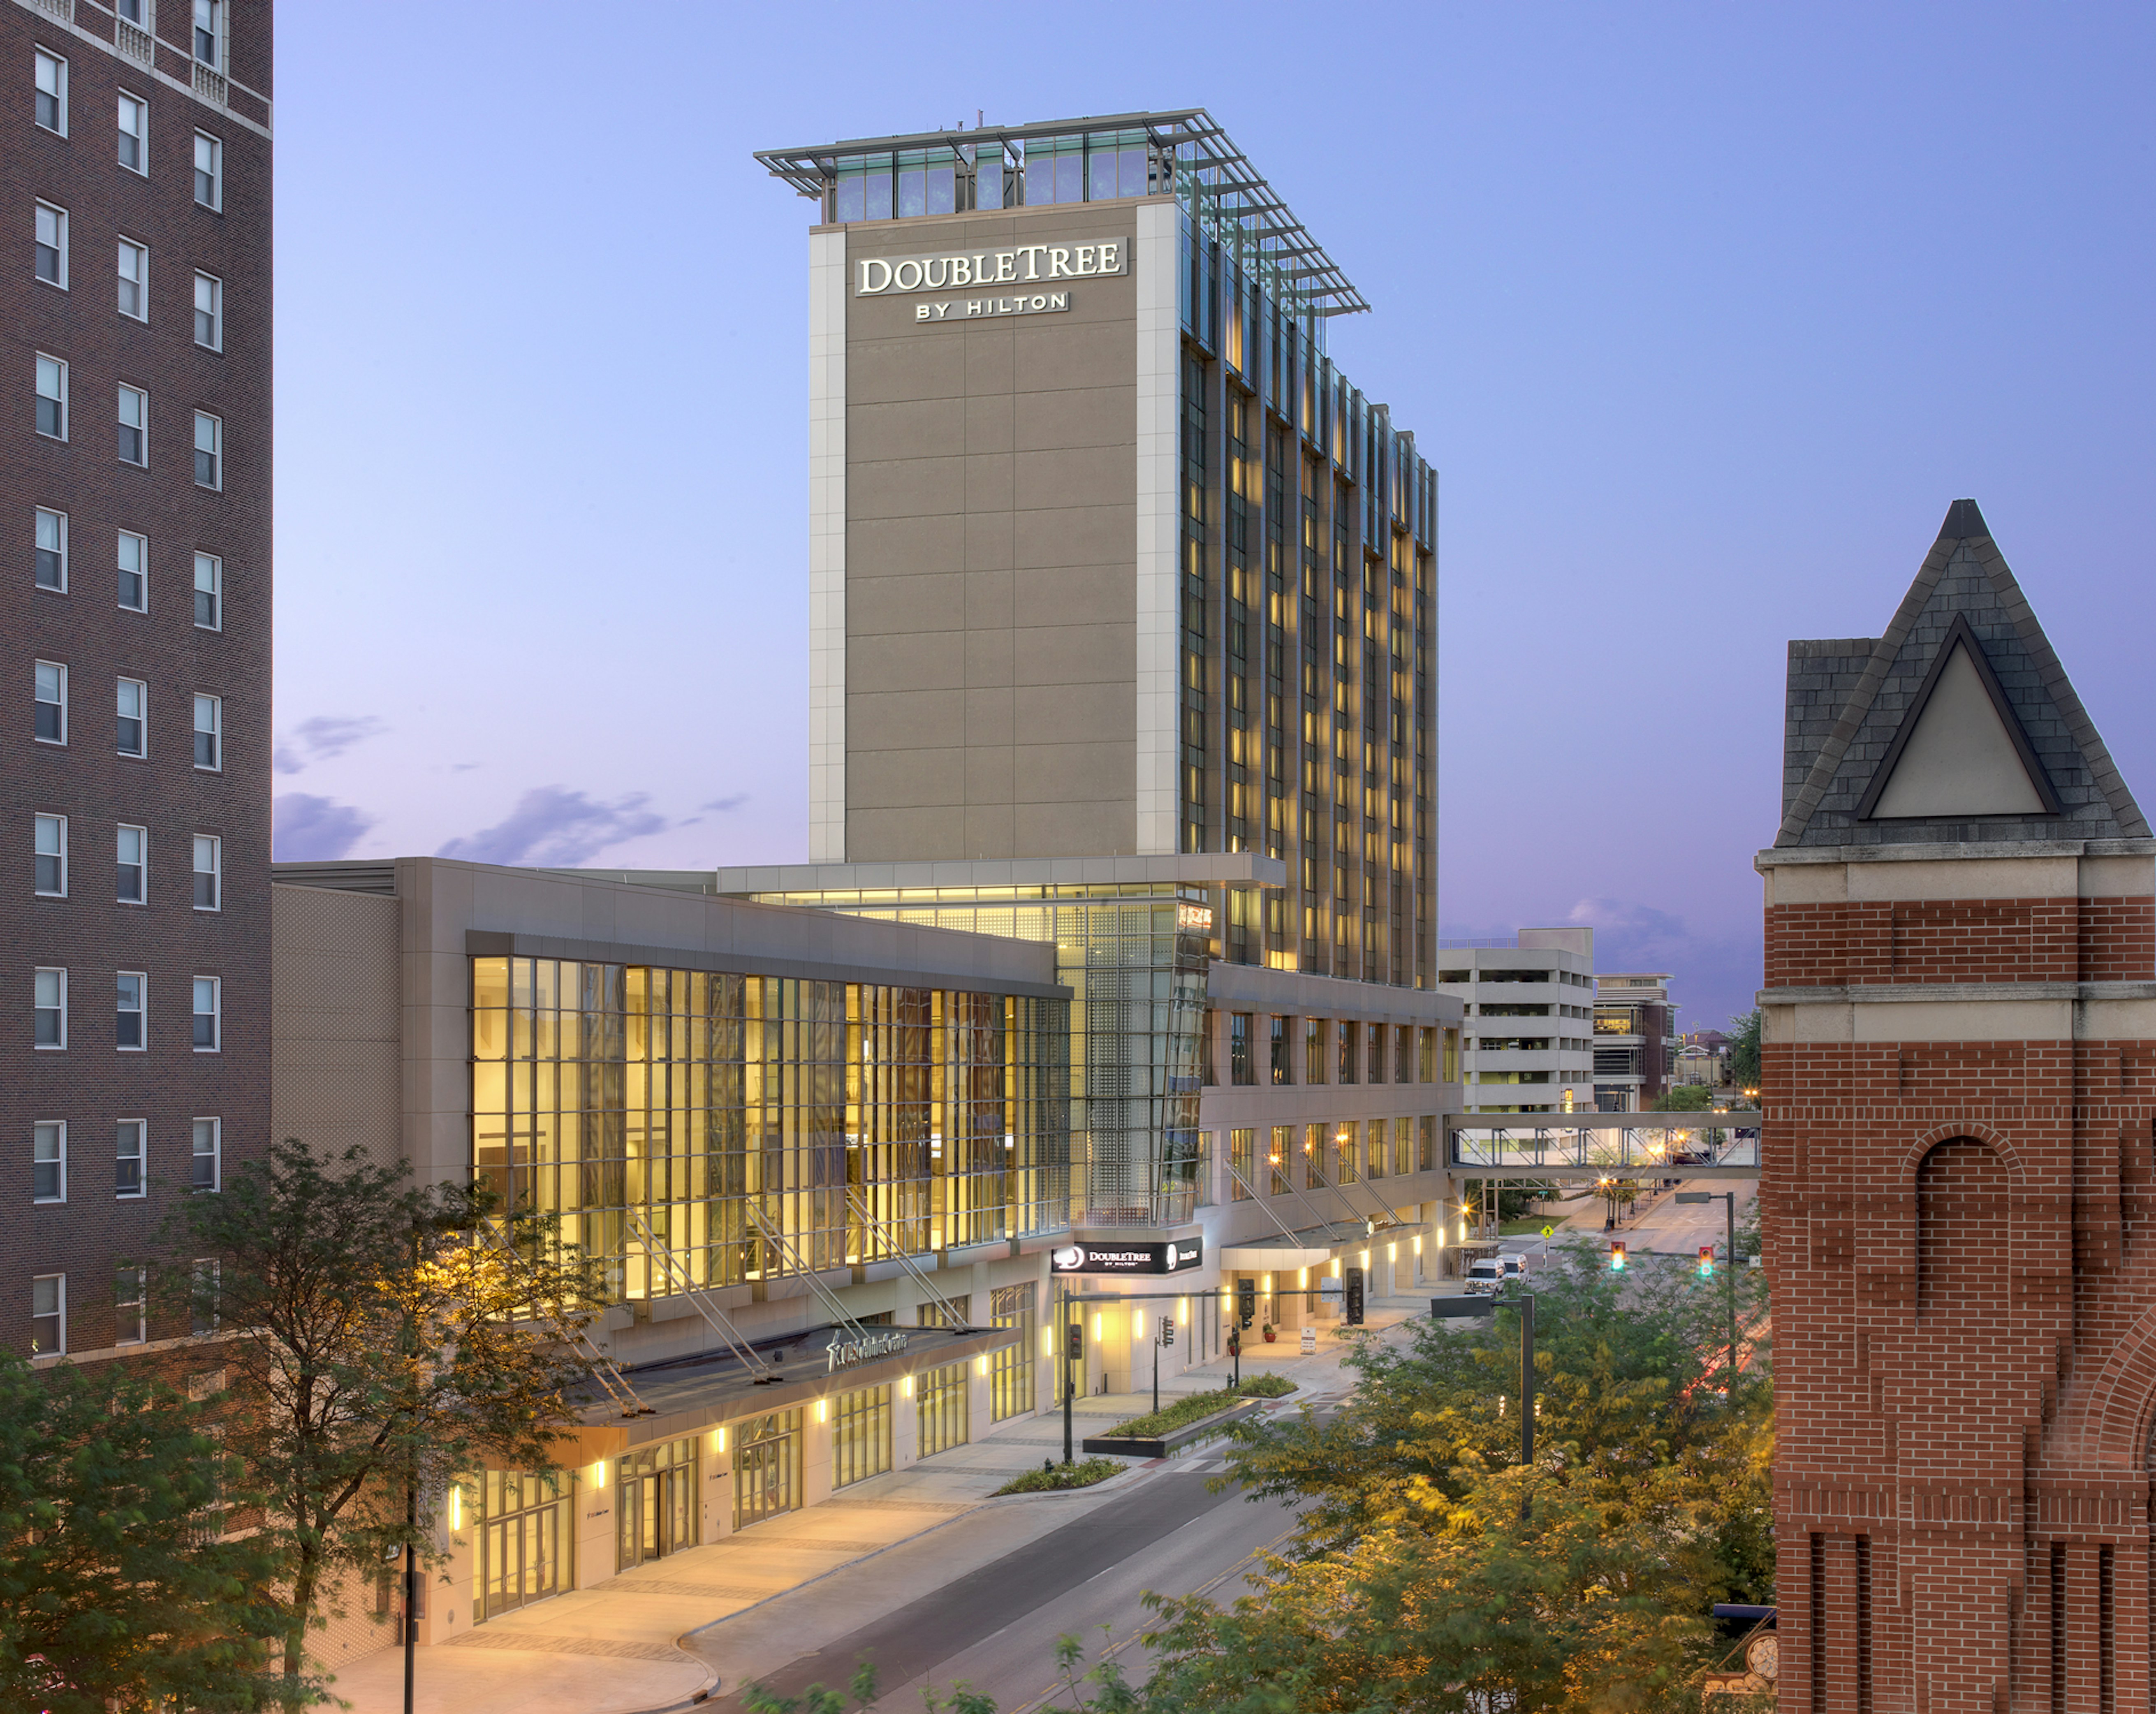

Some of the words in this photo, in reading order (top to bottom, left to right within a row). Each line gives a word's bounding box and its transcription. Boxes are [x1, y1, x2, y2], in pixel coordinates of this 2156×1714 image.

[860, 244, 1121, 293] DOUBLETREE
[917, 303, 950, 320] BY
[967, 293, 1066, 315] HILTON
[1089, 1251, 1151, 1261] DOUBLETREE
